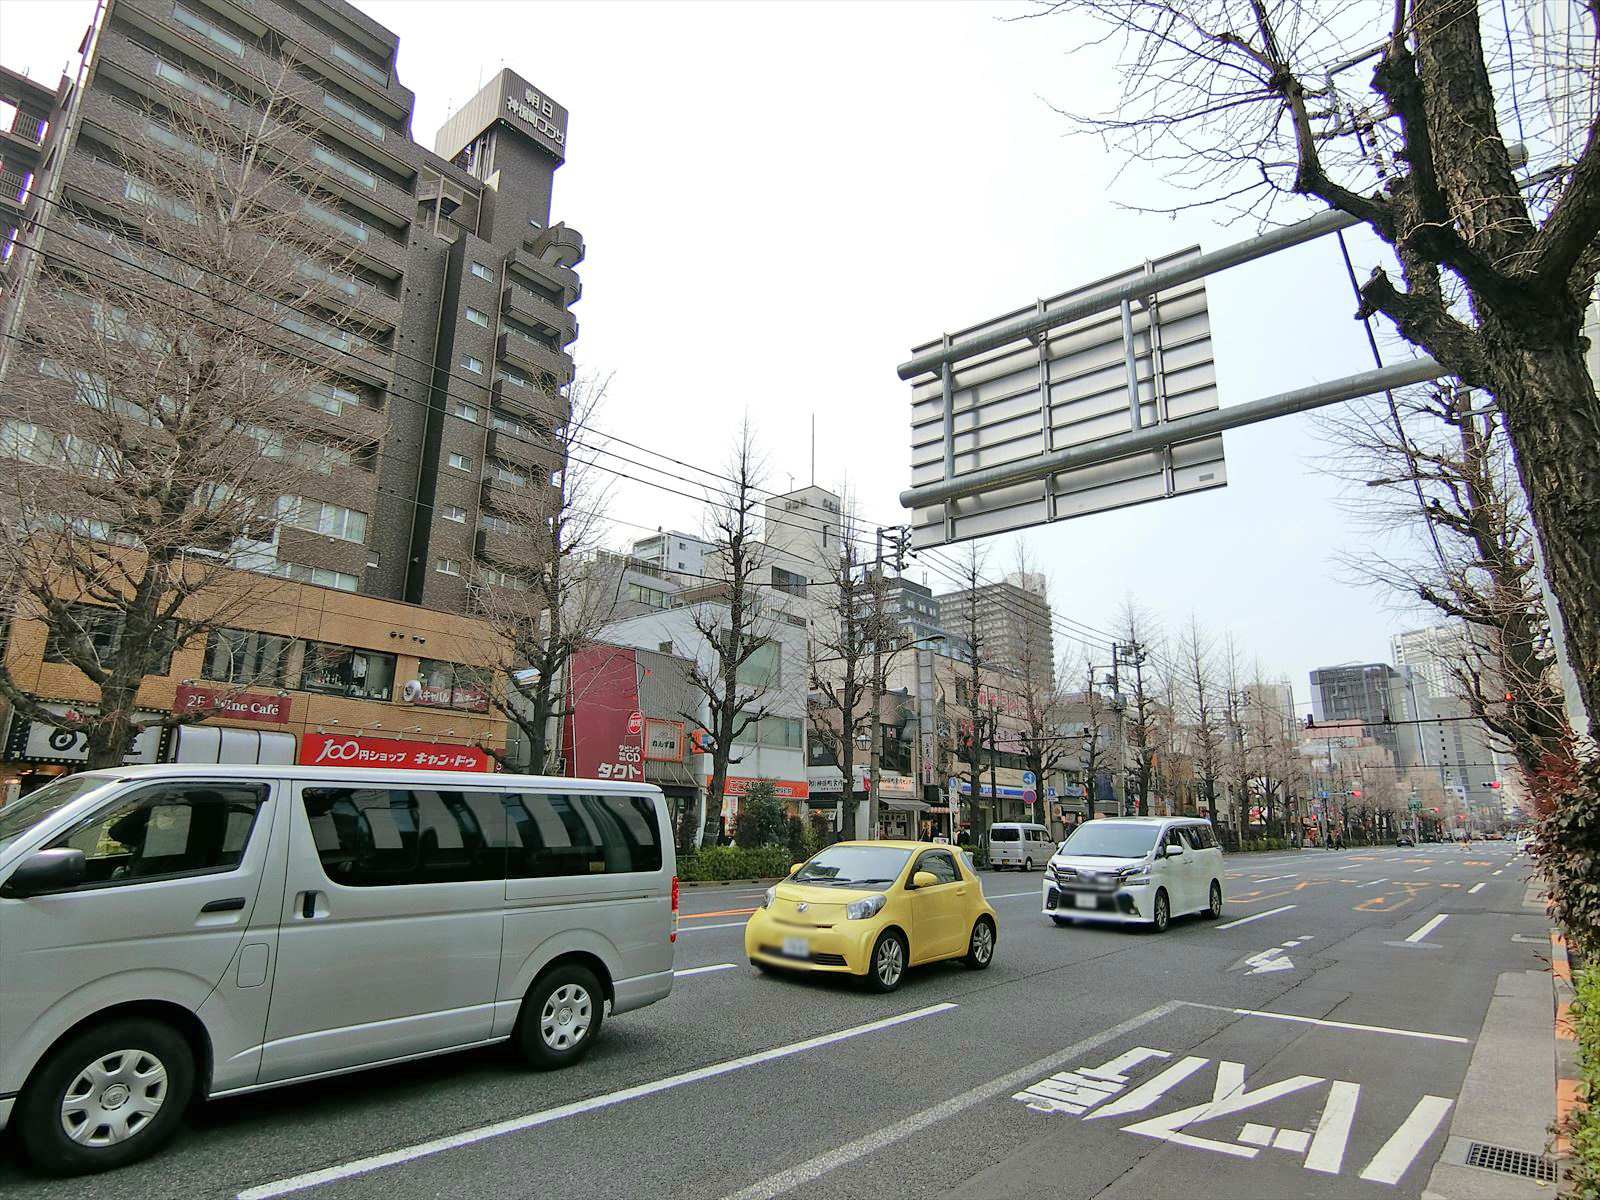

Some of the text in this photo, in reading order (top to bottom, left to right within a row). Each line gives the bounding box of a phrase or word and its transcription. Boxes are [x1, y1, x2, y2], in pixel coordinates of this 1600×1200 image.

[525, 88, 553, 118] 朝日
[214, 698, 248, 712] Wine
[250, 701, 280, 716] Café
[597, 762, 642, 779] タクト
[1010, 1046, 1454, 1185] バス停
